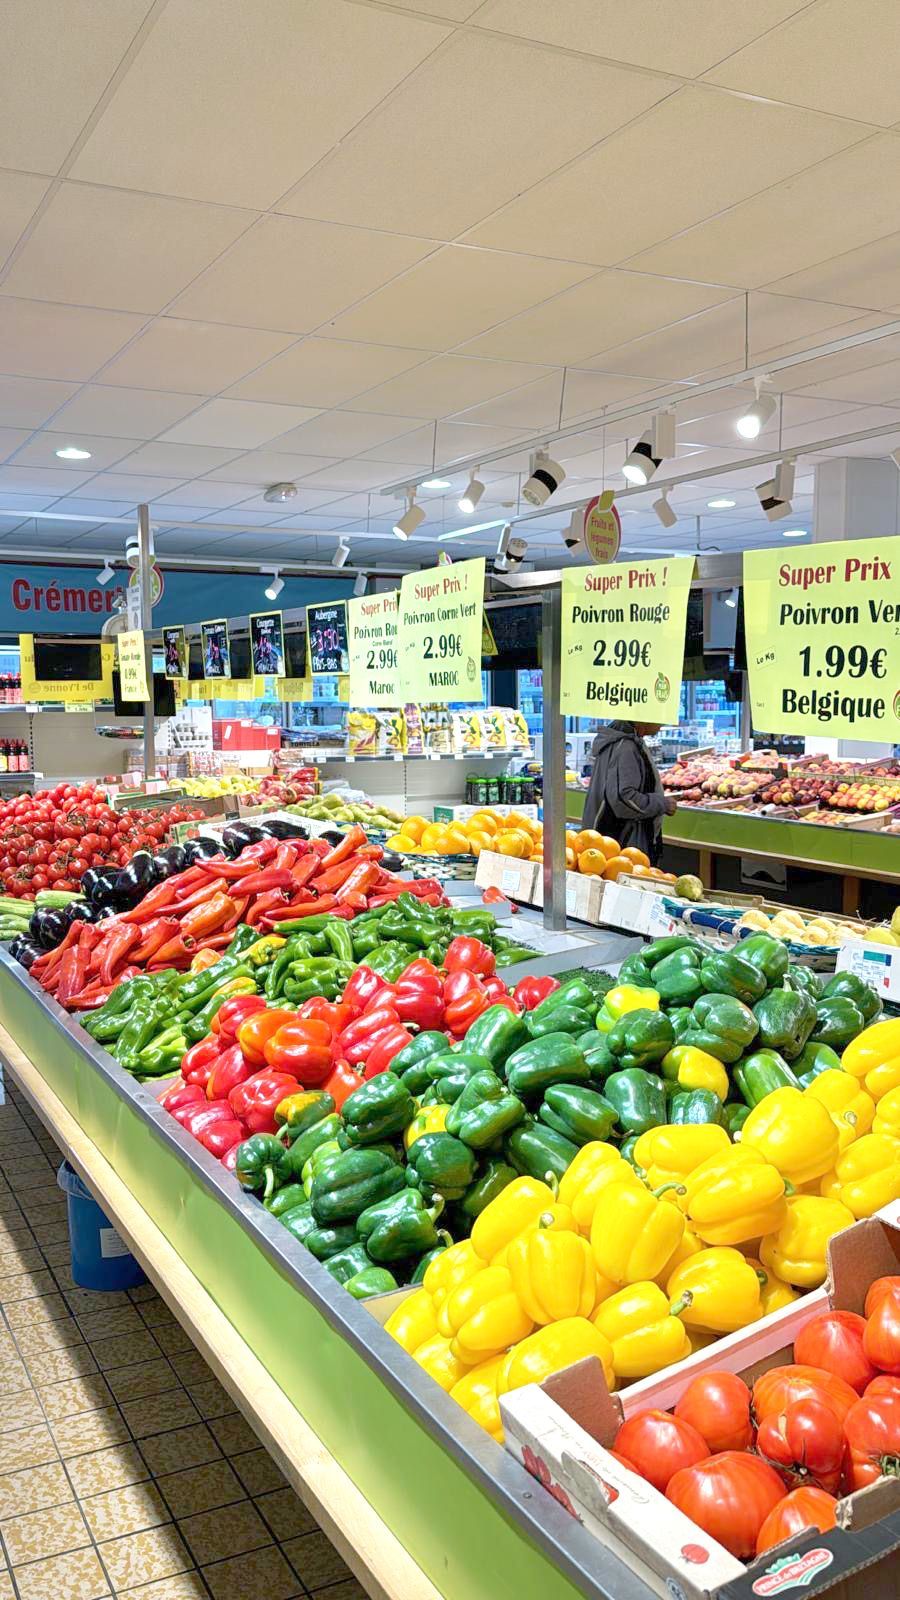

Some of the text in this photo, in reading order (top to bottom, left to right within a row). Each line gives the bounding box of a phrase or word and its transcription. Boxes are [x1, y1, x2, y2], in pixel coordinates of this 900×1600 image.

[585, 566, 668, 595] Super Prix !
[779, 556, 892, 590] Super Prix
[12, 578, 122, 613] Crémer
[415, 582, 440, 602] Super
[443, 576, 461, 595] Prix
[315, 609, 337, 621] Aubergine
[361, 602, 380, 617] Super
[404, 602, 476, 626] Poivron Corne Vert
[572, 603, 670, 624] Poivron Rouge
[780, 600, 900, 625] Poivron Ver
[354, 624, 383, 639] Poivron
[423, 633, 463, 659] 2.99€
[593, 639, 652, 667] 2.99€
[765, 652, 775, 661] Kg
[366, 649, 398, 669] 2.99€
[799, 645, 888, 679] 1.99€
[369, 681, 395, 695] Maroc
[429, 670, 459, 687] MAROC
[586, 681, 648, 707] Belgique
[782, 689, 885, 723] Belgique
